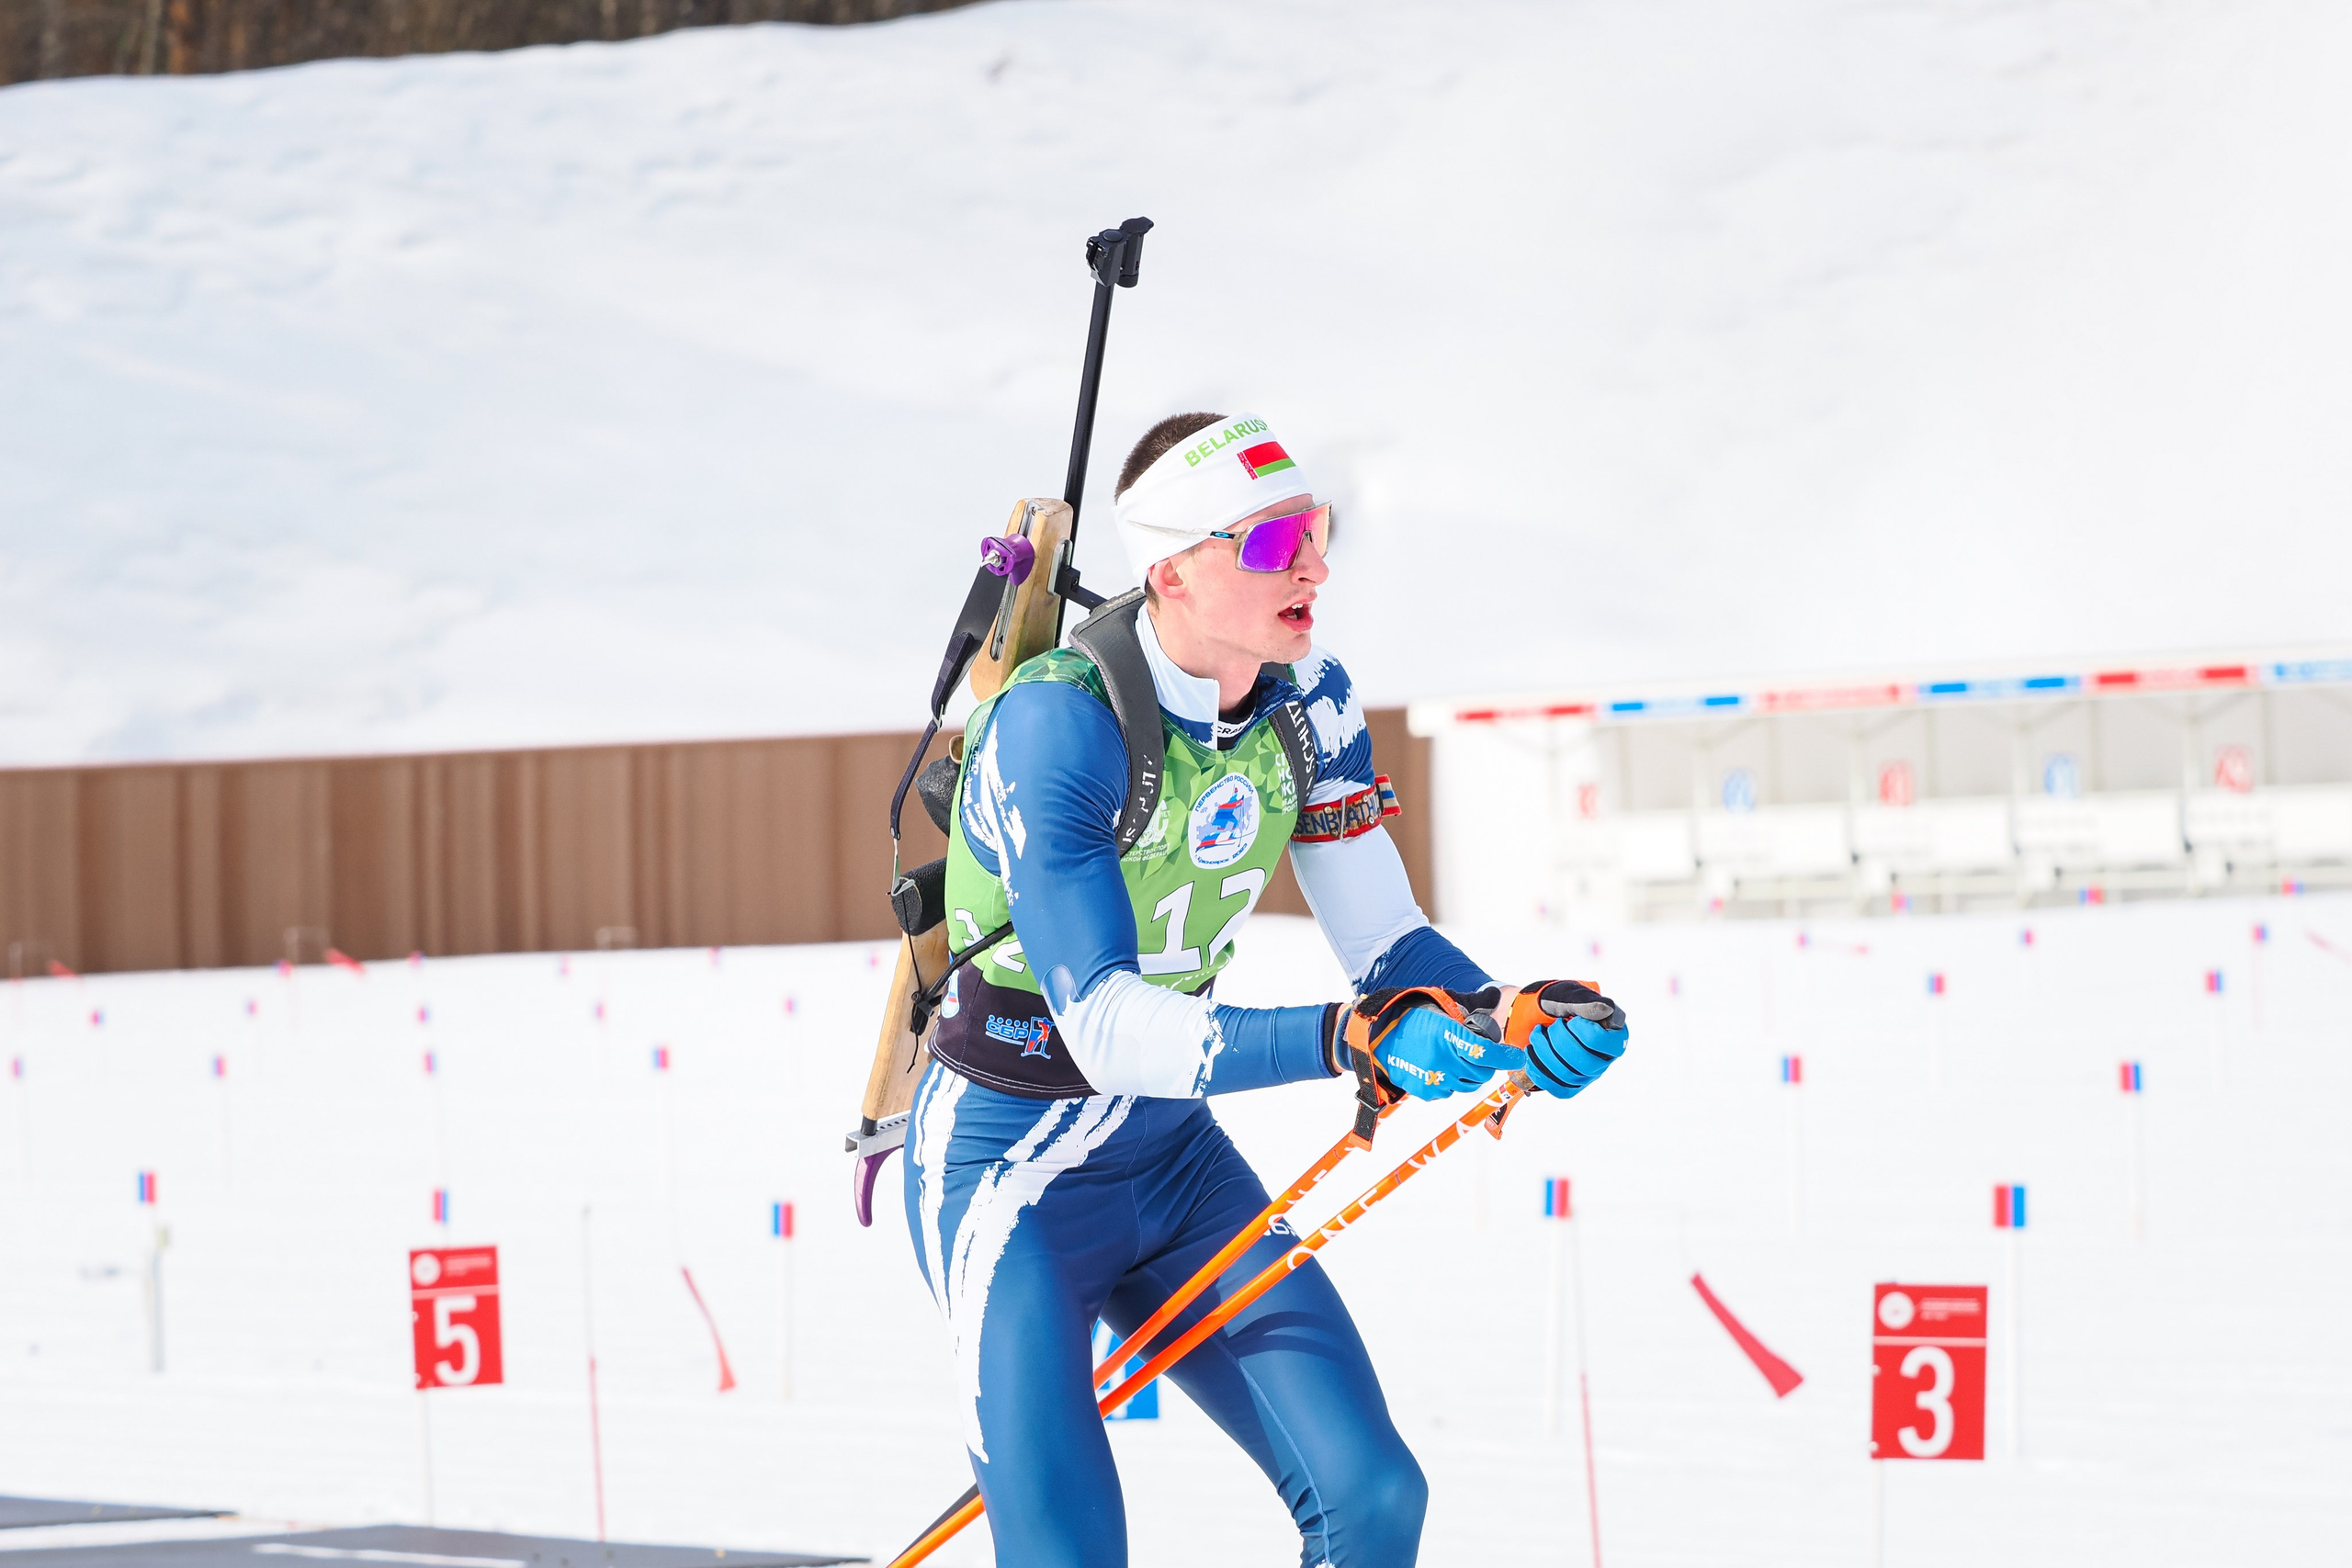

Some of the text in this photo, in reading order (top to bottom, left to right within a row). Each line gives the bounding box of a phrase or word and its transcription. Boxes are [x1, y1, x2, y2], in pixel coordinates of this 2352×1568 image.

[1183, 419, 1268, 467] BELARUS
[1137, 867, 1267, 976] 12
[986, 1020, 1029, 1040] СБР
[434, 1295, 481, 1385] 5
[1897, 1346, 1955, 1459] 3
